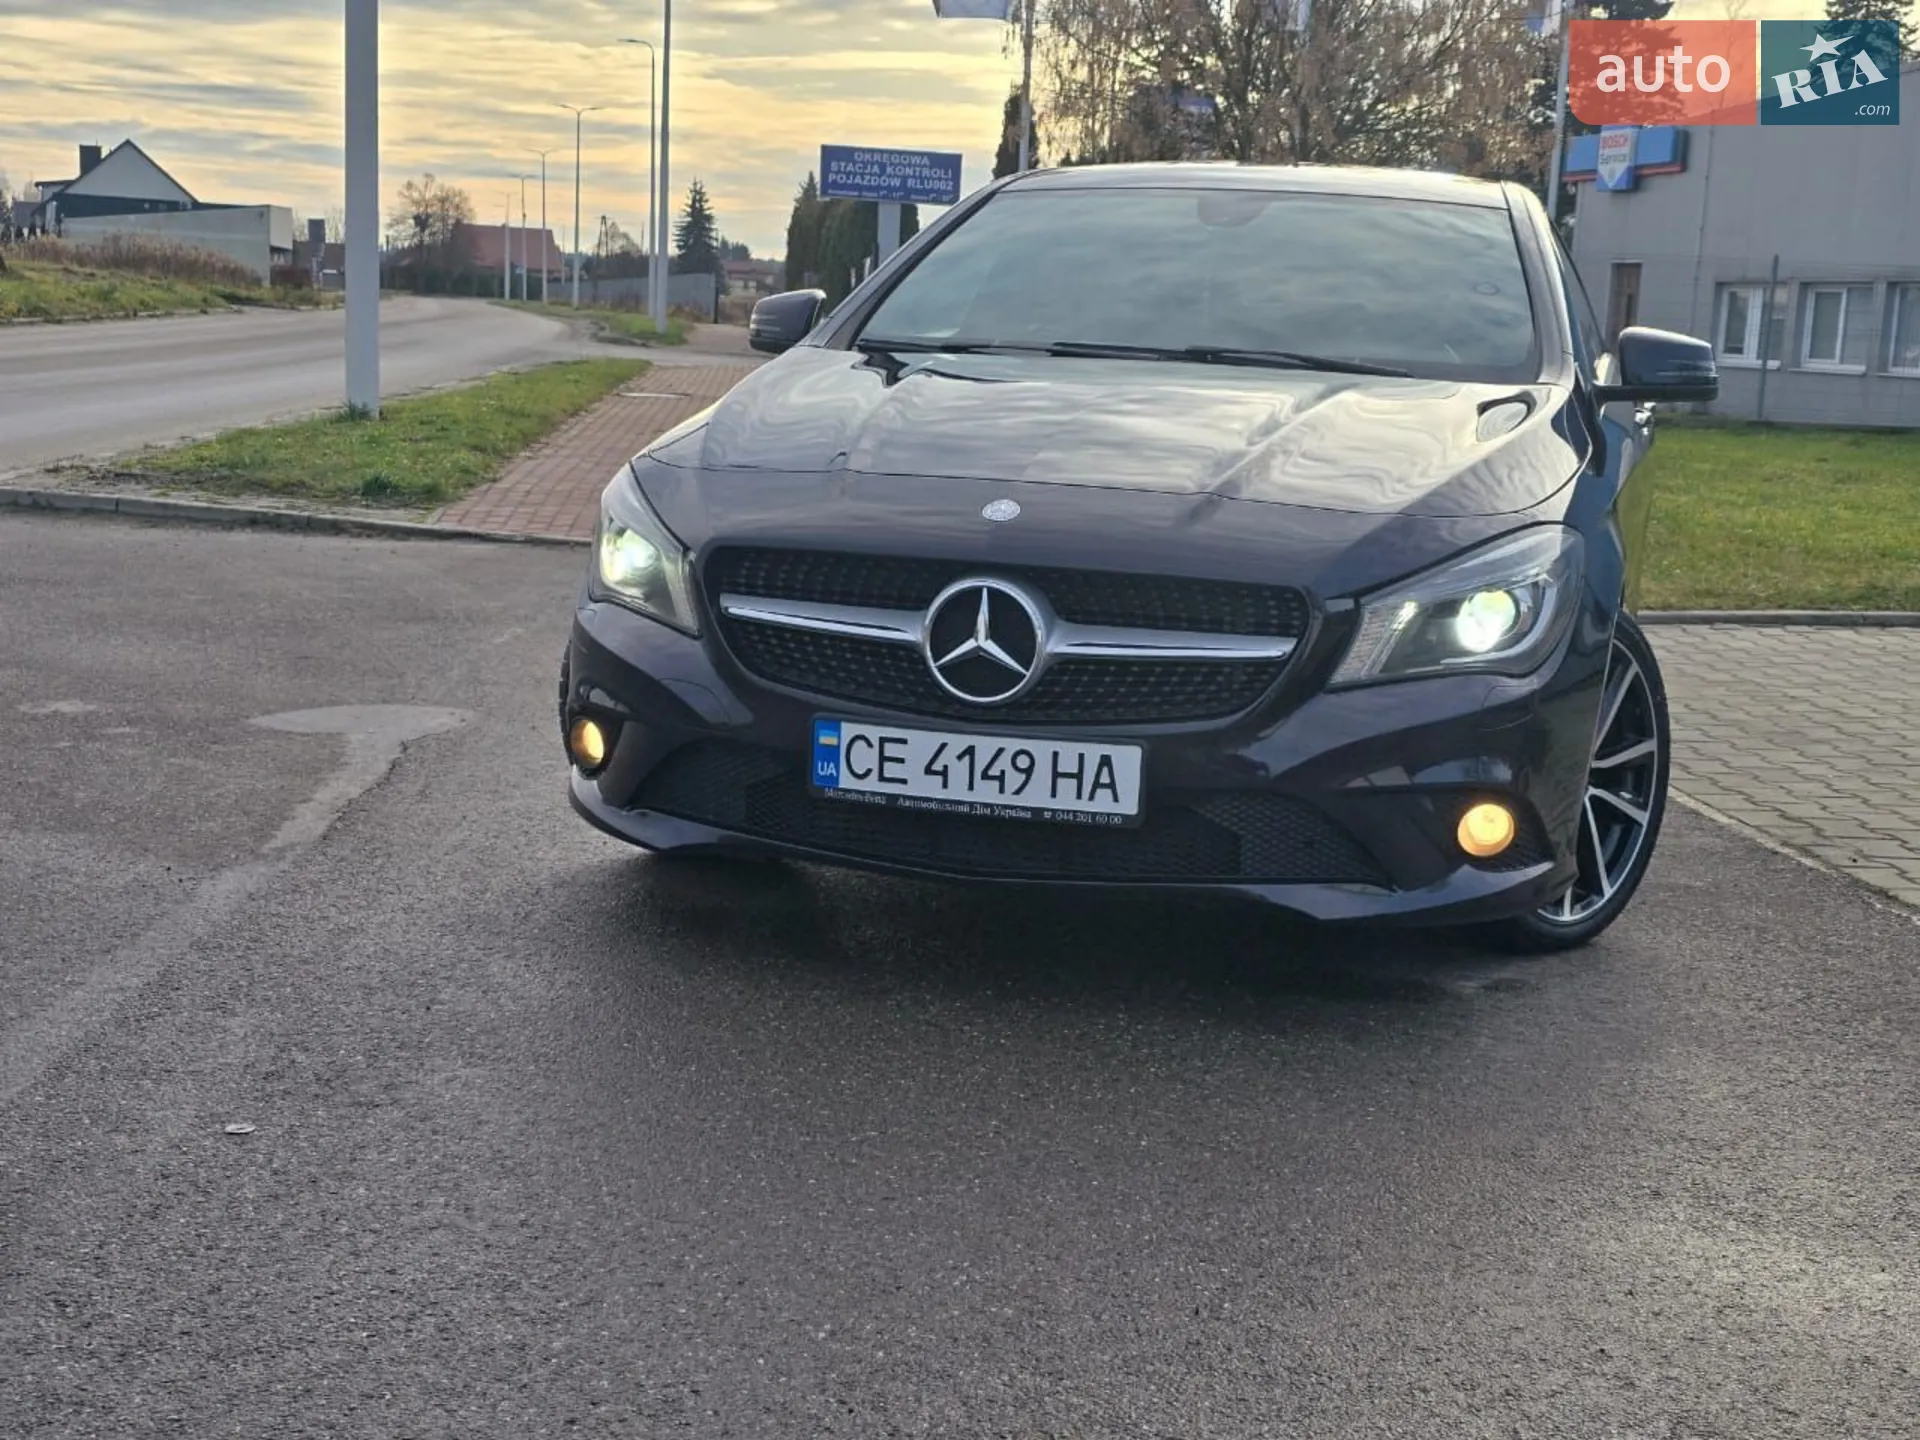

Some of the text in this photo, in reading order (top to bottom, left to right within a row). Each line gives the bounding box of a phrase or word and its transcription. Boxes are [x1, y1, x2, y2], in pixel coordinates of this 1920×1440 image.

[830, 161, 952, 178] STACJA KONTROLI
[817, 762, 837, 777] UA
[845, 734, 1120, 803] CE 4149 HA
